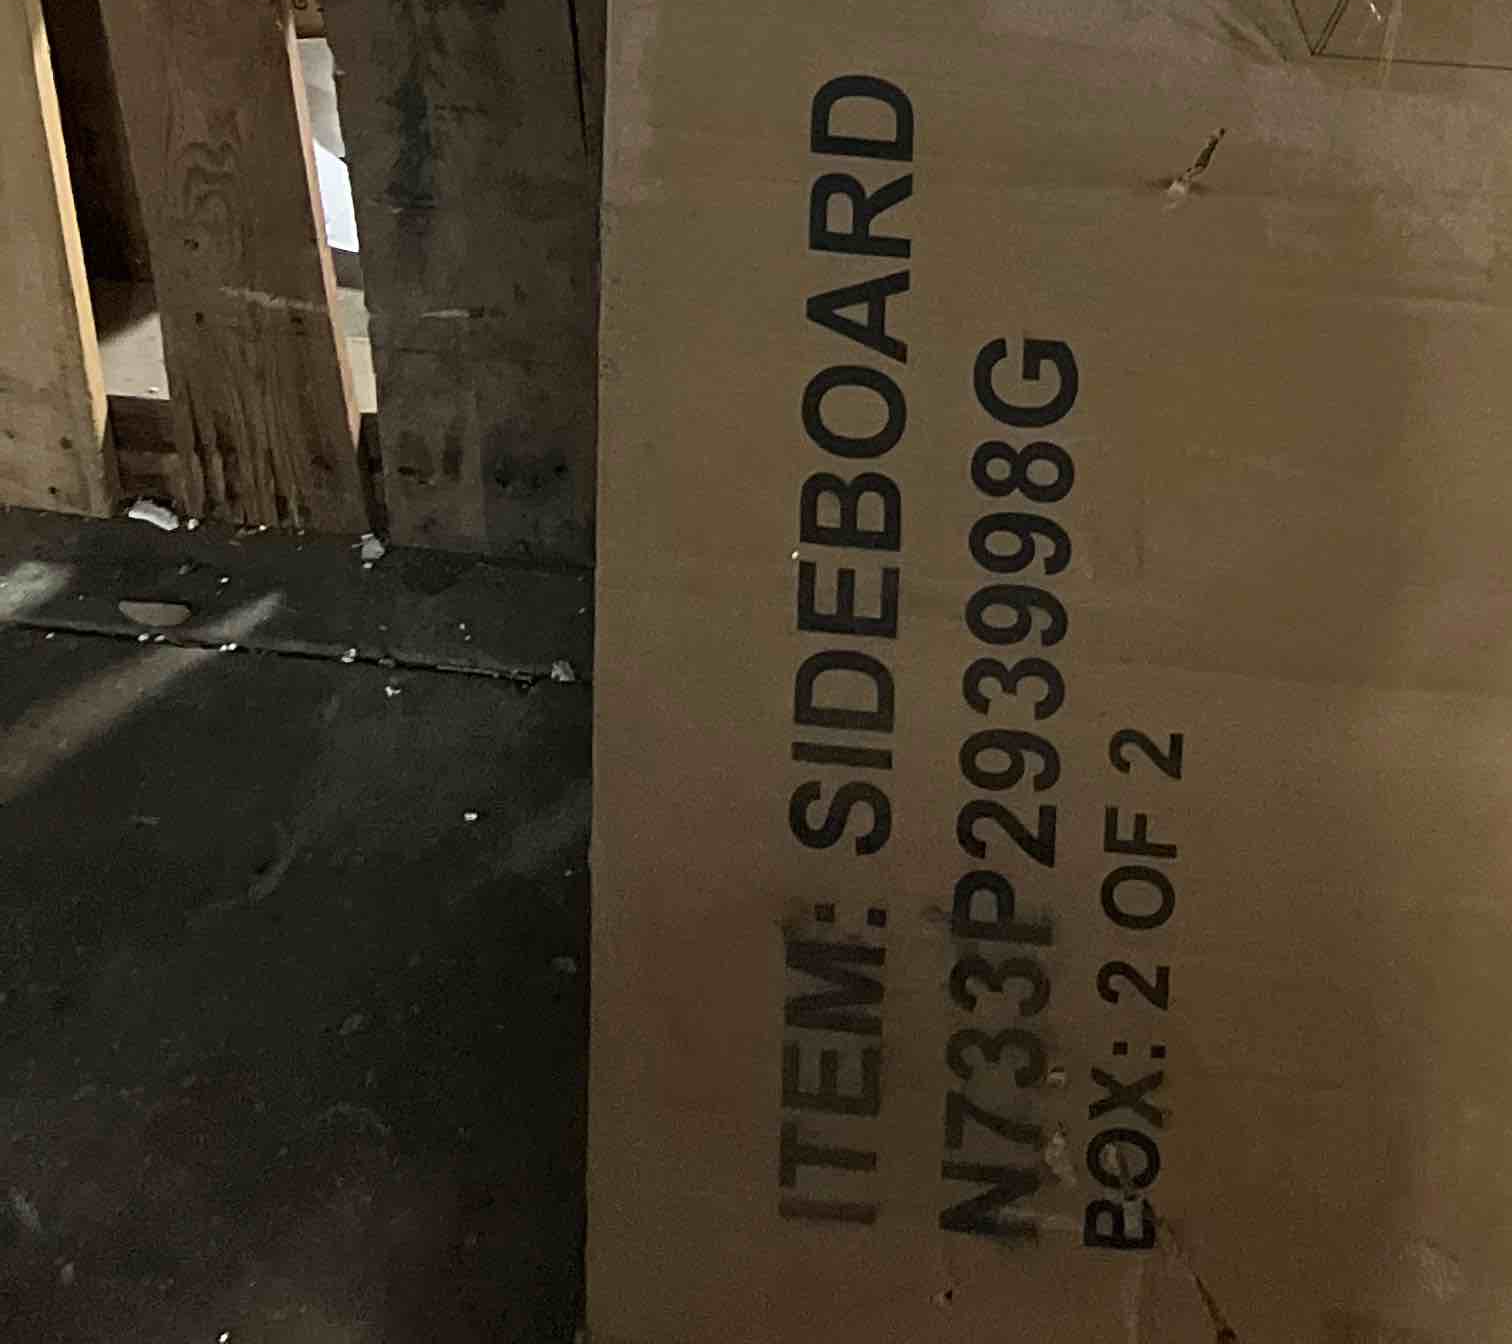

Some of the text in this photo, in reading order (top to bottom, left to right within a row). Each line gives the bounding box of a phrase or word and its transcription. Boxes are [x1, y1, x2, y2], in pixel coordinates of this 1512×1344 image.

[779, 74, 915, 1226] ITEM: SIDEBOARD
[938, 337, 1080, 1247] N733P293998G
[1082, 728, 1184, 1250] BOX: 2 OF 2
